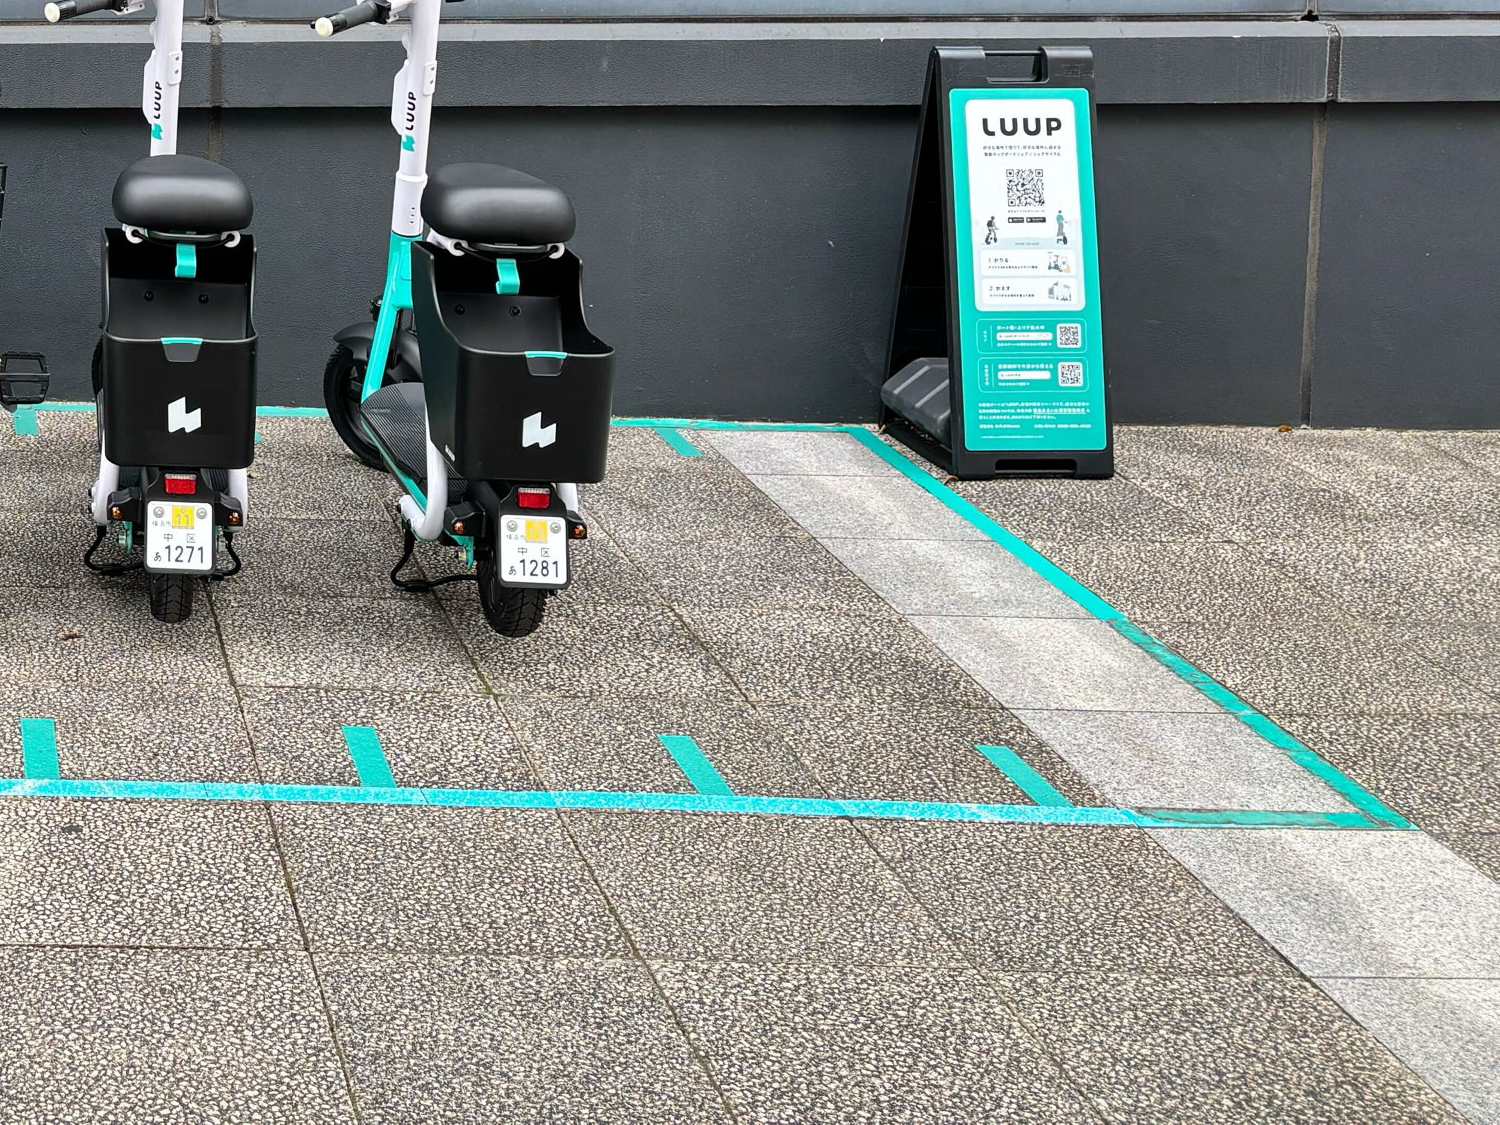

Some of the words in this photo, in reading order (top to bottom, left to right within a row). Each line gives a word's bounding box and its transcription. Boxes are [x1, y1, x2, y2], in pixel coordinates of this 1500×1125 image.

[153, 81, 163, 120] LUUP
[405, 91, 417, 131] LUUP
[982, 117, 1062, 137] LUUP
